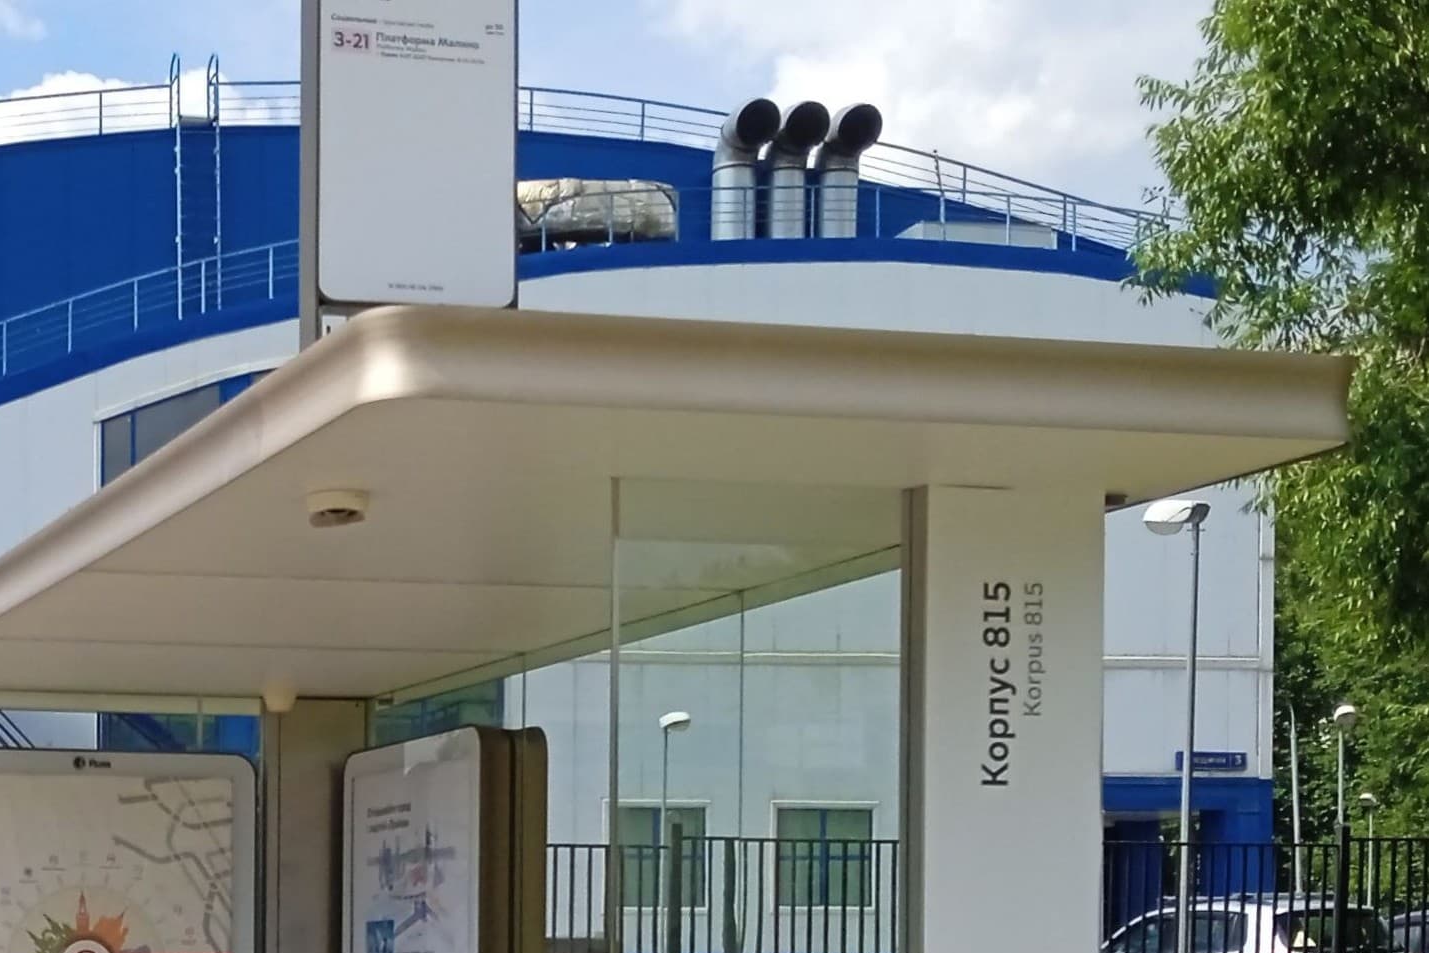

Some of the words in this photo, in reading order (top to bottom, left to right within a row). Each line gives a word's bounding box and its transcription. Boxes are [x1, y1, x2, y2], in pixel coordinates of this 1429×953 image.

[982, 581, 1012, 648] 815
[1023, 582, 1044, 625] 815
[1023, 633, 1046, 716] Korpus
[981, 657, 1016, 786] Корпус
